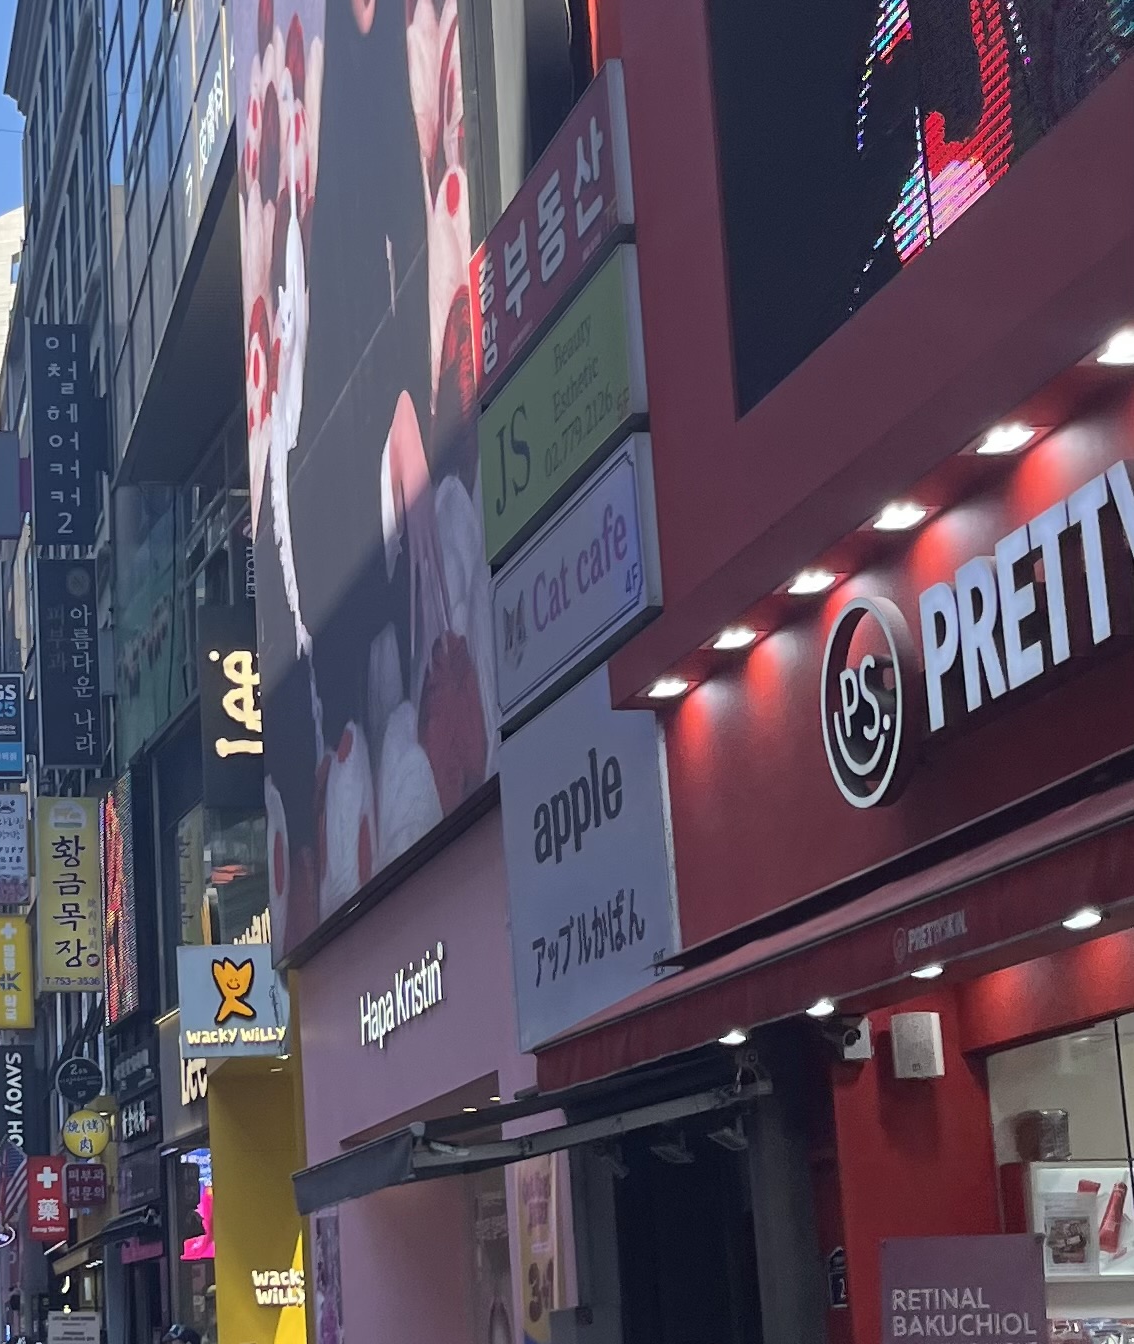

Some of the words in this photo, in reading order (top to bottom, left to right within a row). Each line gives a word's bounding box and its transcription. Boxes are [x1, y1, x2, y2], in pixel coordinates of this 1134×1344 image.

[504, 116, 603, 318] 부동산
[479, 252, 498, 374] 중앙
[553, 315, 591, 375] Beauty
[496, 402, 531, 516] JS
[533, 558, 571, 632] Cat
[577, 504, 628, 594] cafe
[625, 563, 638, 594] 4F
[70, 604, 94, 698] 아름다운
[74, 709, 96, 755] 나라
[534, 748, 623, 864] apple
[51, 835, 87, 968] 황금목장
[532, 889, 645, 987] アップルかばん
[360, 992, 394, 1049] Hapa
[5, 1052, 23, 1115] SAVOY
[68, 1169, 104, 1182] 피부과
[69, 1186, 105, 1202] 전문의
[892, 1287, 990, 1312] RETINAL
[892, 1312, 1037, 1337] BAKUCHIOL
